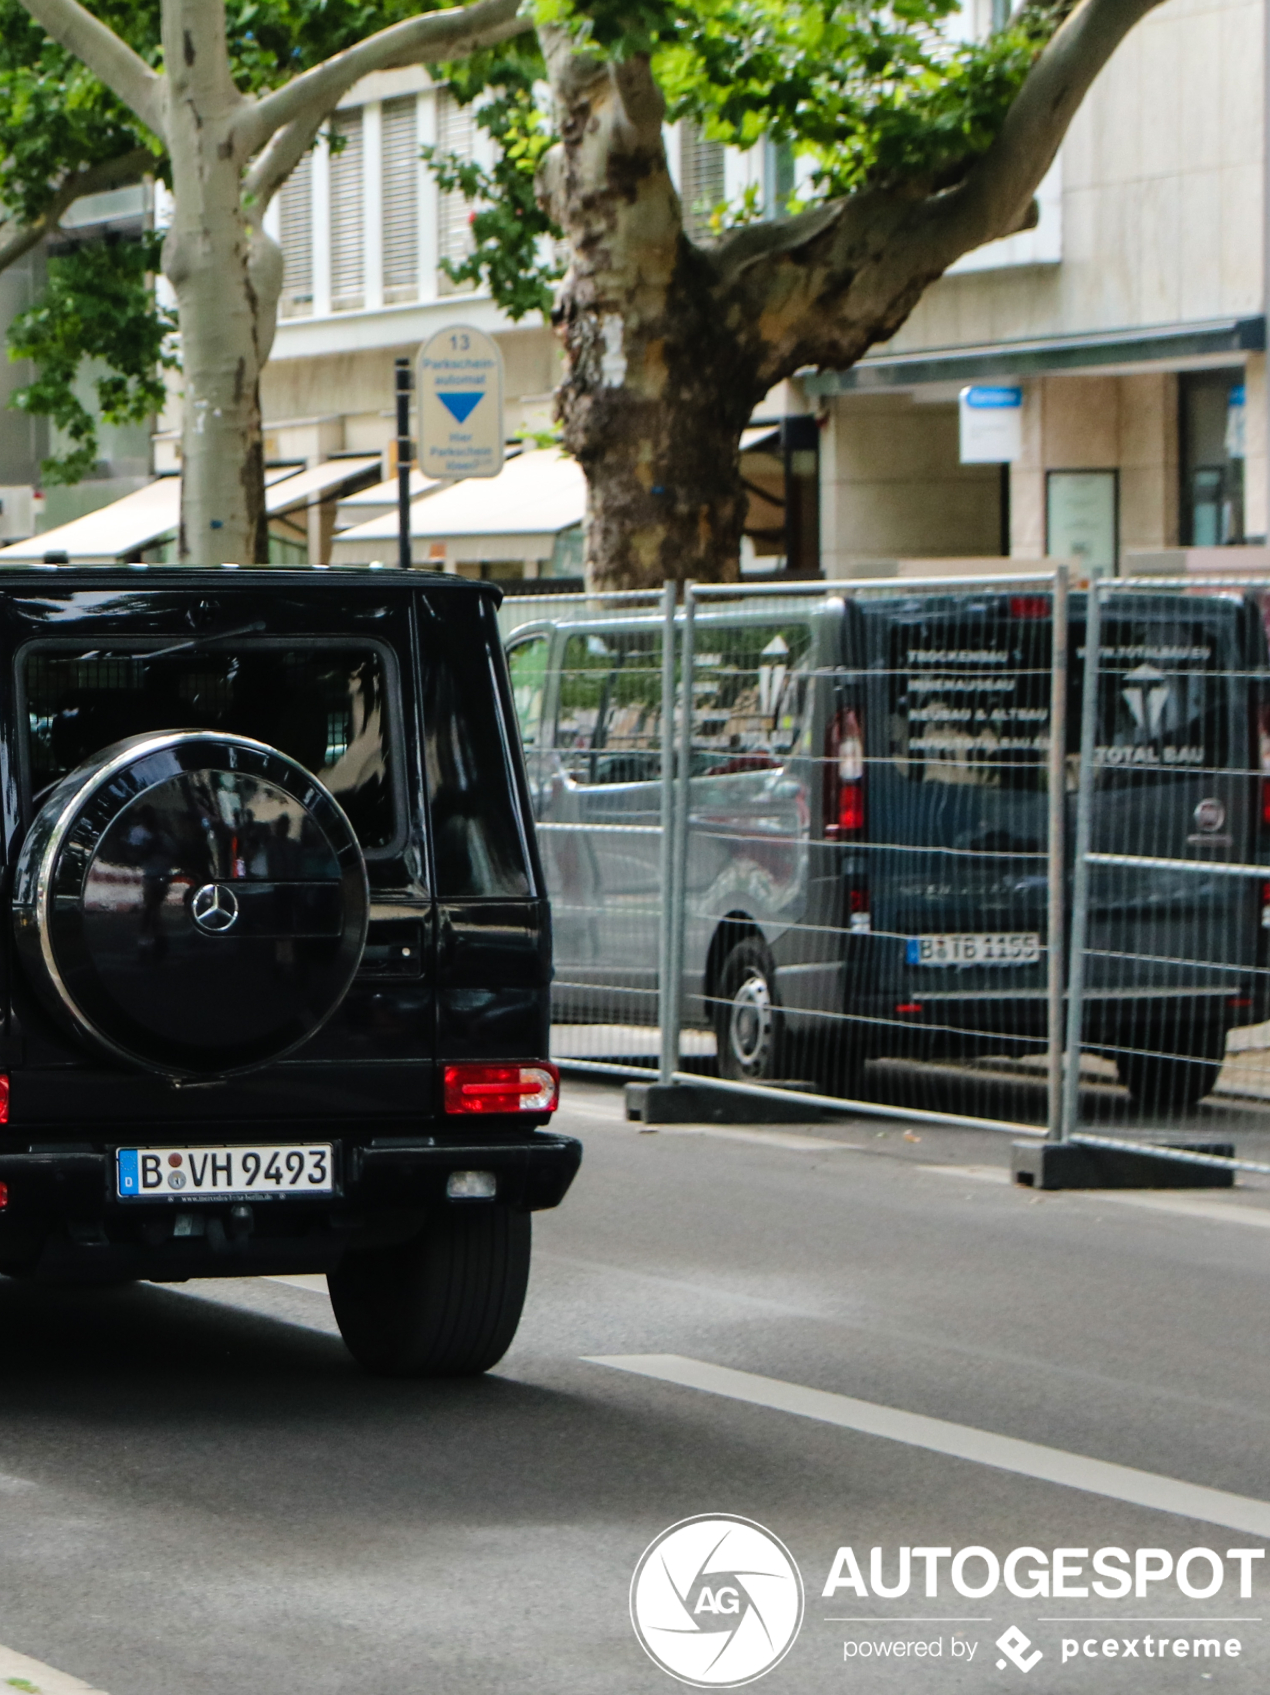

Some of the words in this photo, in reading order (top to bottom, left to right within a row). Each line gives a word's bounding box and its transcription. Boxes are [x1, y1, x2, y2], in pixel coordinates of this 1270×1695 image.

[450, 334, 470, 350] 13
[434, 375, 486, 385] automat
[430, 447, 493, 457] Parkschein
[1094, 746, 1160, 763] TOTAL
[1163, 747, 1204, 764] BAU
[141, 1154, 163, 1189] B
[188, 1152, 233, 1187] VH
[241, 1150, 327, 1186] 9493
